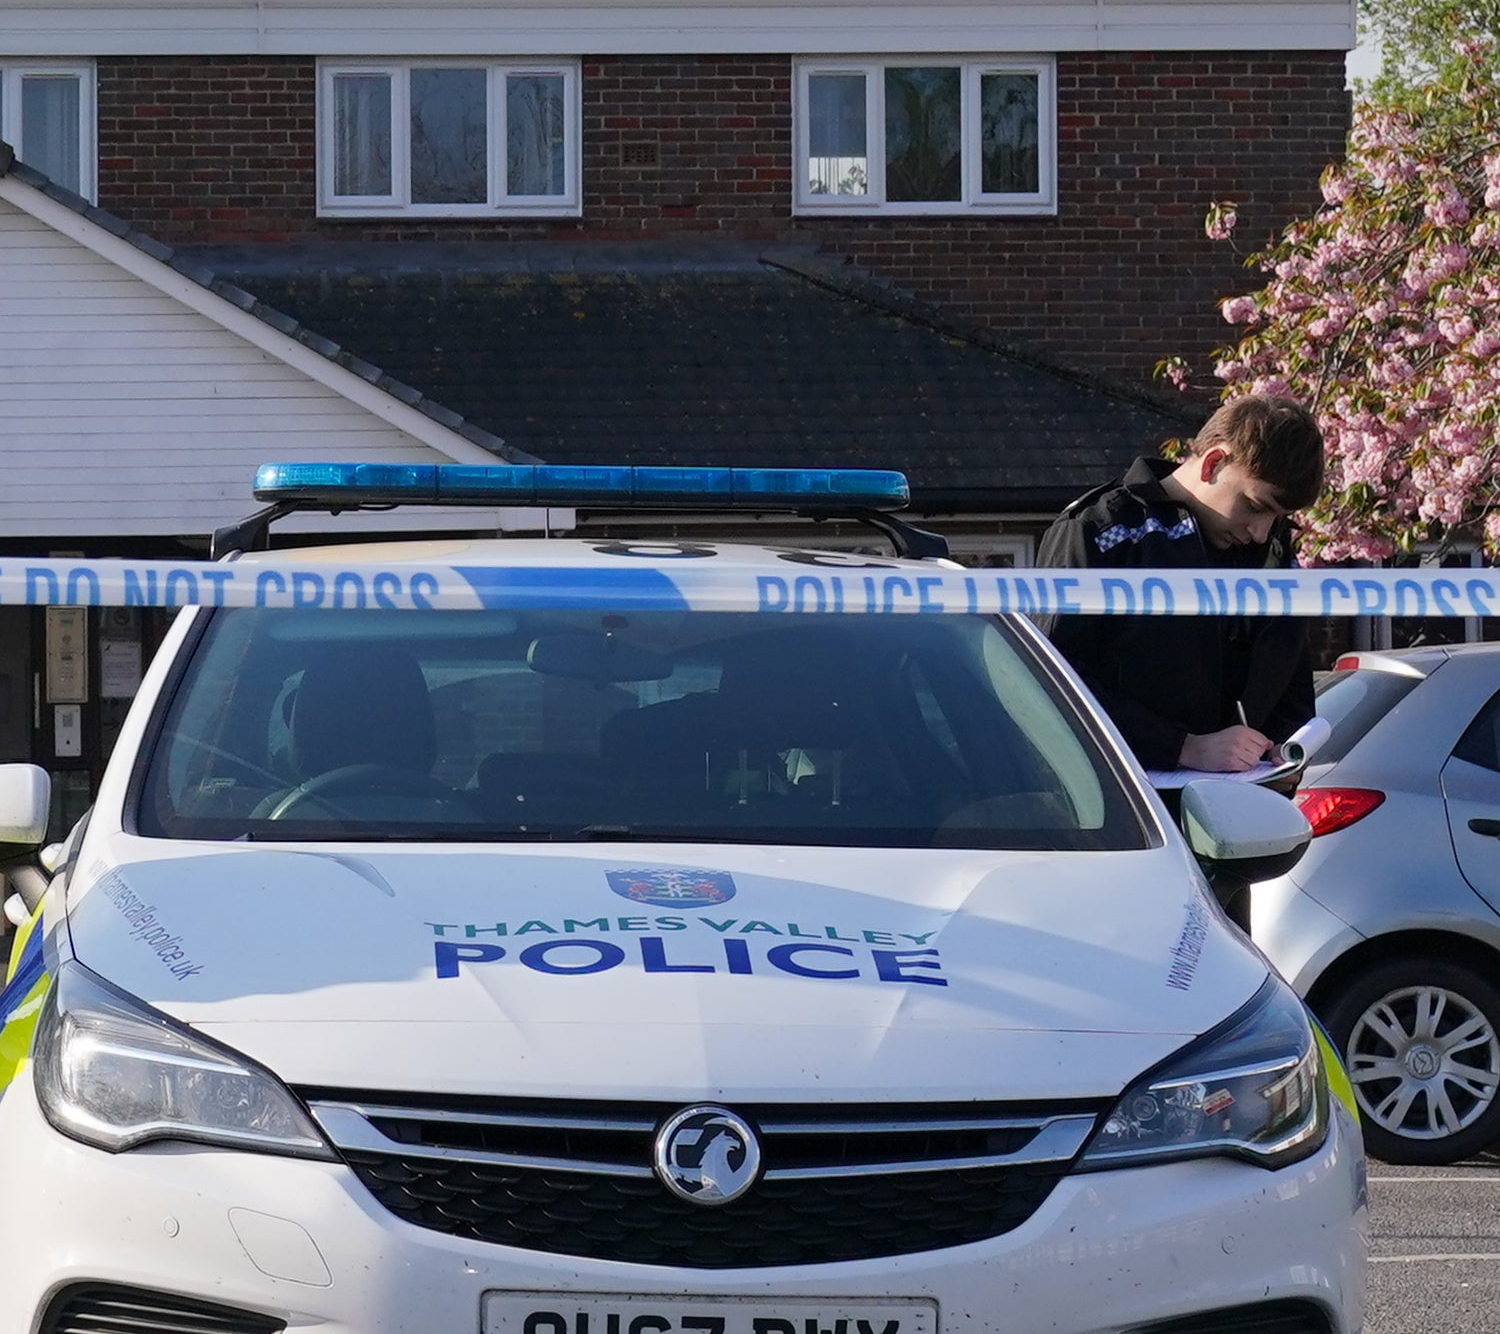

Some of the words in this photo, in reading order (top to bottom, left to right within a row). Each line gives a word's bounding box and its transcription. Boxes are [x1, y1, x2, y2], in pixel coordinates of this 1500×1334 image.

[24, 567, 101, 605] DO
[122, 569, 236, 607] NOT
[254, 571, 440, 611] CROSS
[756, 575, 944, 614] POLICE
[962, 577, 1081, 614] LINE
[1100, 576, 1175, 615] DO
[1192, 577, 1301, 616] NOT
[1319, 577, 1496, 617] CROSS
[424, 916, 688, 938] THAMES
[698, 917, 939, 946] VALLEY
[434, 936, 949, 987] POLICE
